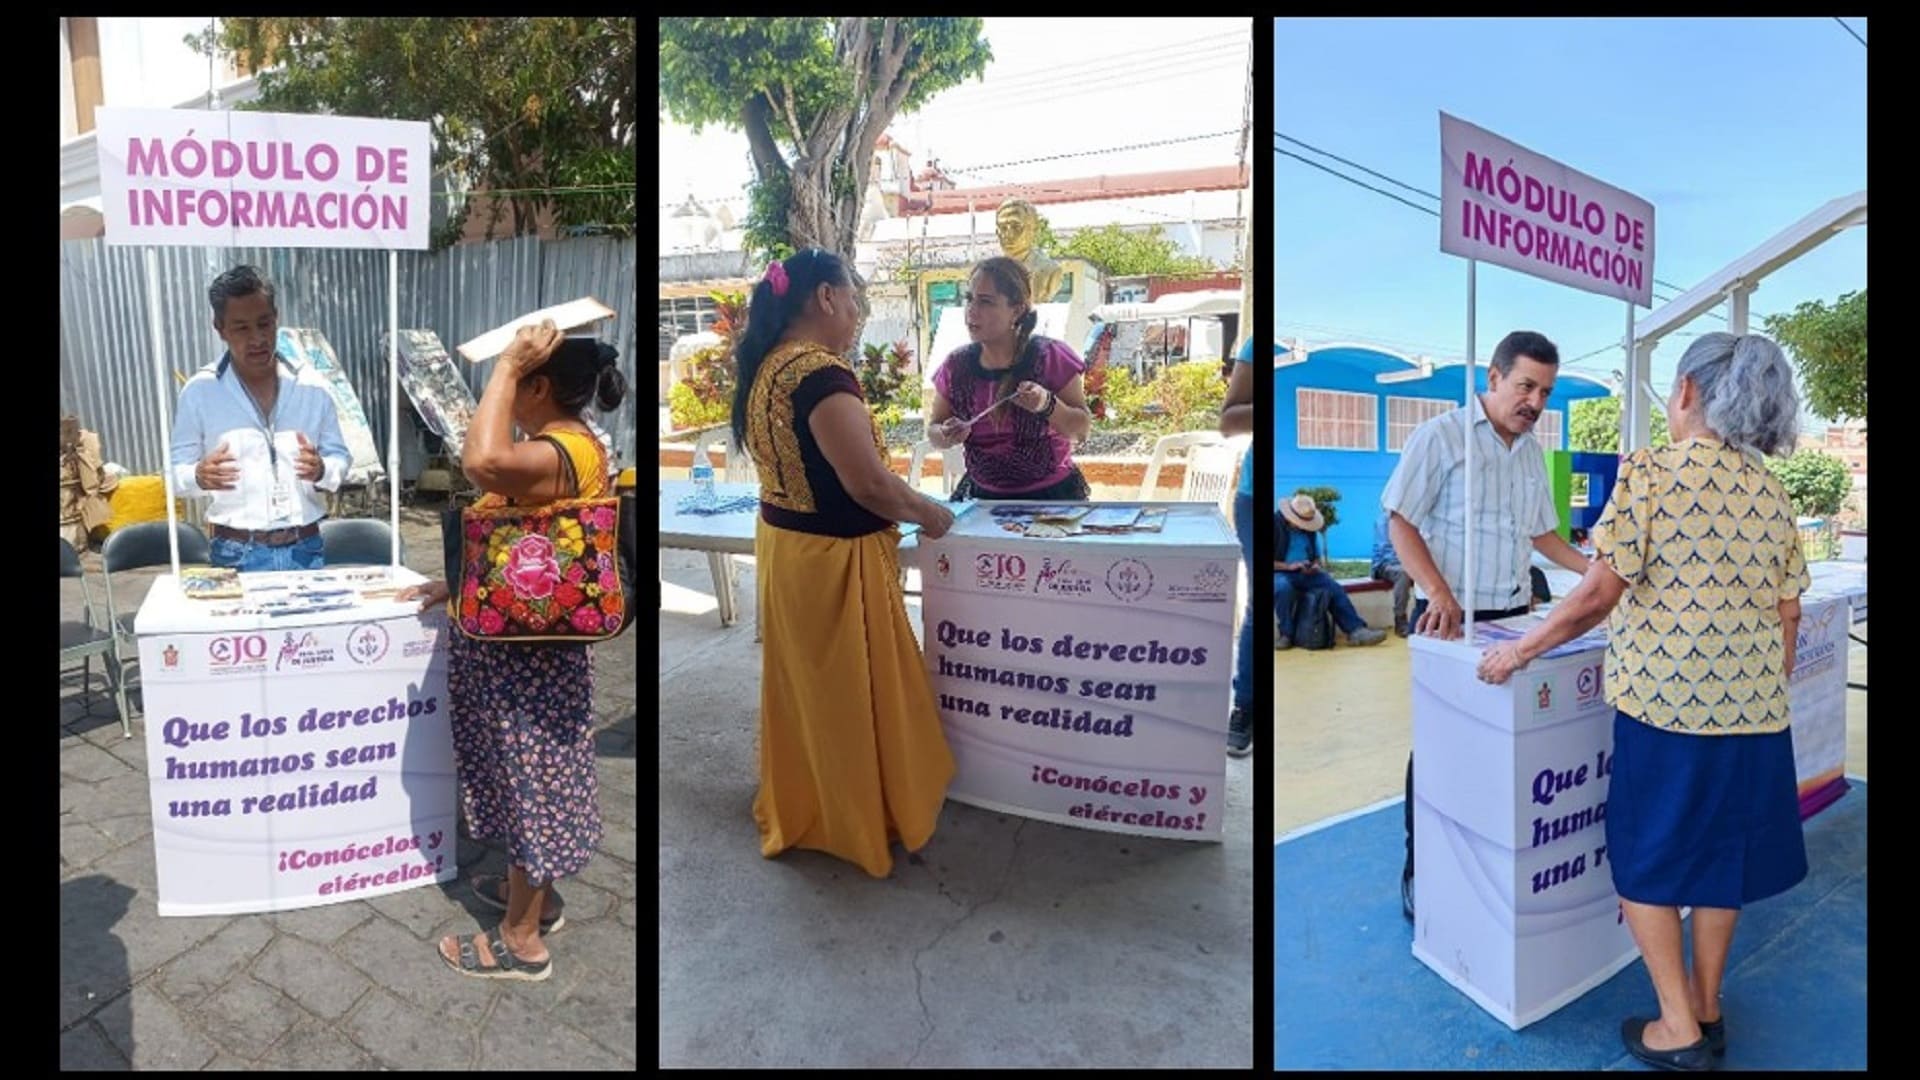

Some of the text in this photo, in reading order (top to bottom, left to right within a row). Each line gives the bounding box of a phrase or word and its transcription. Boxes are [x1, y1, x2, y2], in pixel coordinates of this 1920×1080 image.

[127, 129, 407, 183] MÓDULO DE
[127, 185, 408, 230] INFORMACIÓN
[1464, 151, 1645, 252] MÓDULO DE
[1462, 199, 1643, 290] INFORMACIÓN
[937, 620, 1208, 666] Que los derechos
[938, 655, 1157, 702] humanos sean
[1577, 664, 1603, 698] CJ
[163, 697, 437, 748] Que los derechos
[940, 694, 1133, 737] una realidad
[165, 742, 397, 779] humanos sean
[168, 776, 378, 818] una realidad
[1031, 765, 1207, 805] ¡Conócelos y
[1532, 762, 1588, 805] Que
[1532, 801, 1607, 848] huma
[278, 830, 444, 872] ¡Conócelos y
[1532, 851, 1586, 893] una
